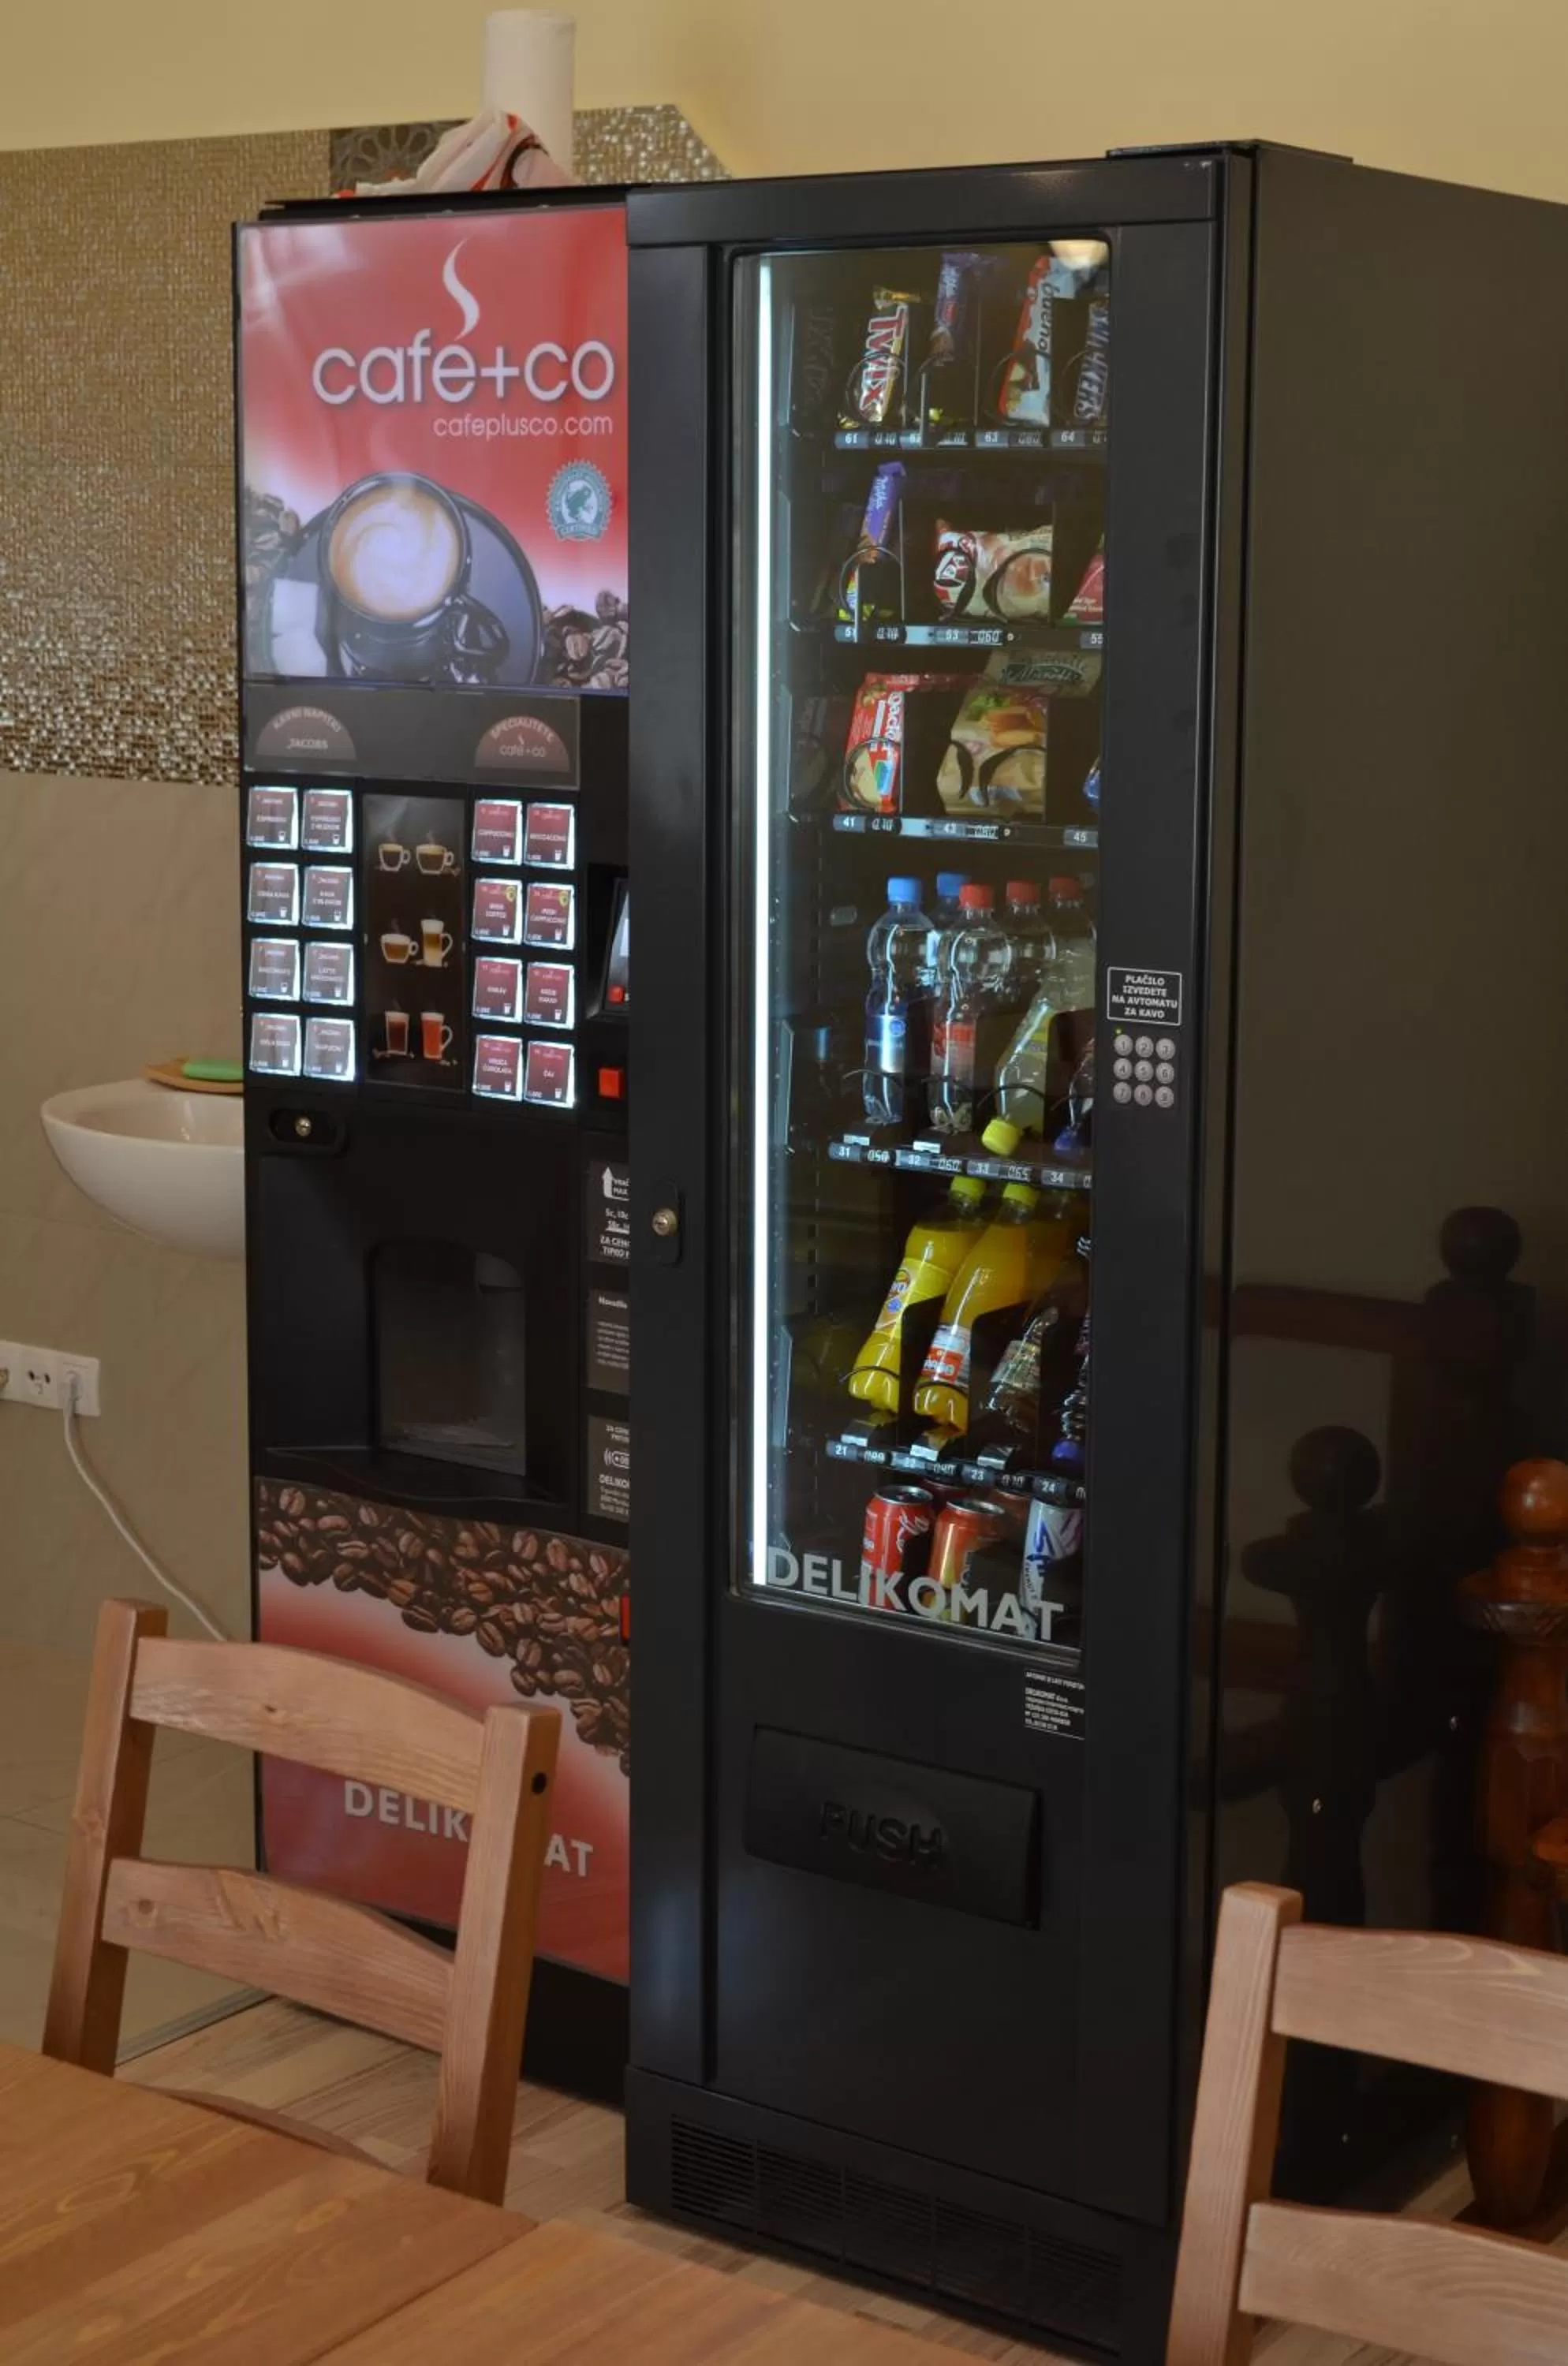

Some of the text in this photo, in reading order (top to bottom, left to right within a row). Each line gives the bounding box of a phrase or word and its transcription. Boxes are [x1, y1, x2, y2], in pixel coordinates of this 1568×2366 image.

[1036, 280, 1061, 353] bueno
[859, 302, 909, 416] TWIX
[433, 413, 613, 442] cafeplusco.com
[1125, 973, 1166, 986] PLAČILO
[1122, 985, 1167, 998] IZVEDETE
[1112, 995, 1178, 1009] NA AVTOMATU
[1124, 1007, 1166, 1019] ZA KAVO
[838, 1146, 851, 1159] 31
[1050, 1171, 1064, 1184] 34
[835, 1444, 847, 1457] 21
[970, 1469, 984, 1481] 23
[1041, 1480, 1056, 1493] 24
[767, 1547, 1065, 1642] DELIKOMAT
[344, 1779, 594, 1877] DELIKAT
[821, 1800, 946, 1869] PUSH
